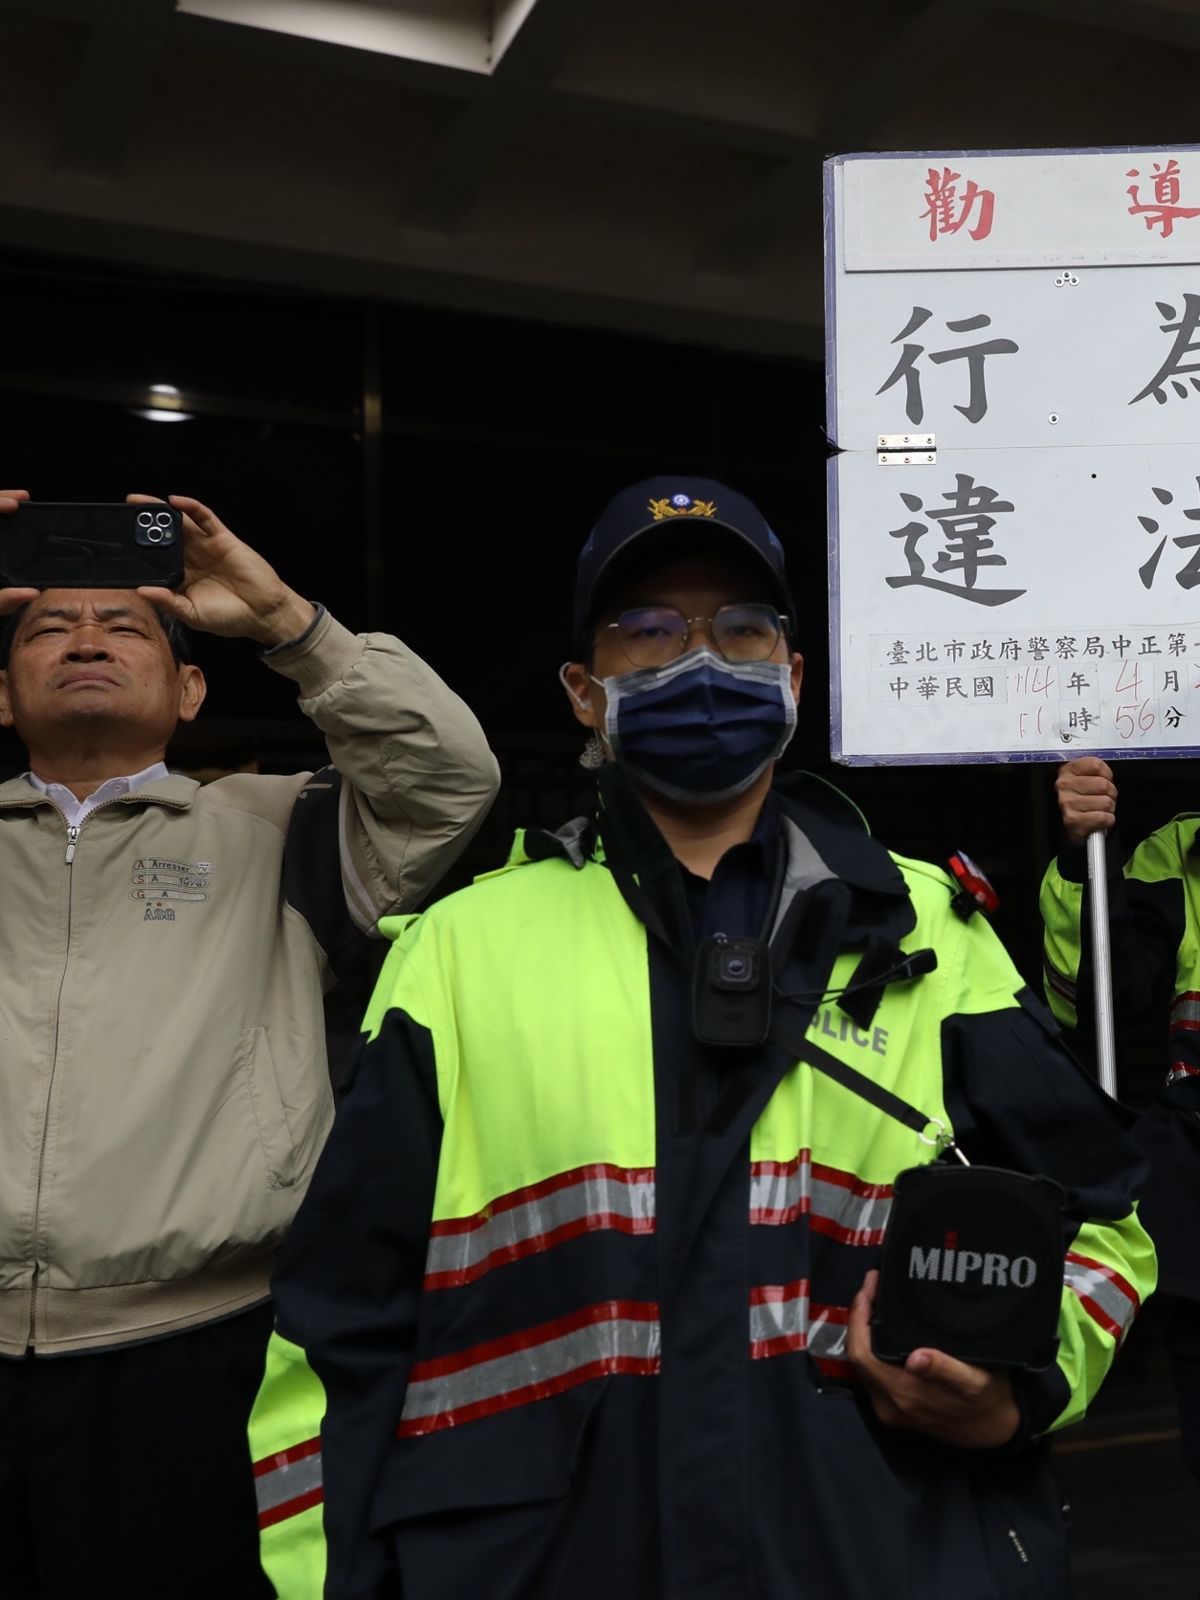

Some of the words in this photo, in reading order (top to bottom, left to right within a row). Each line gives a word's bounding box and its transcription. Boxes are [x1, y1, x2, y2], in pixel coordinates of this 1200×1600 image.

[888, 676, 995, 701] 中華民國
[143, 908, 176, 921] ASG
[908, 1232, 1037, 1288] MIPRO
